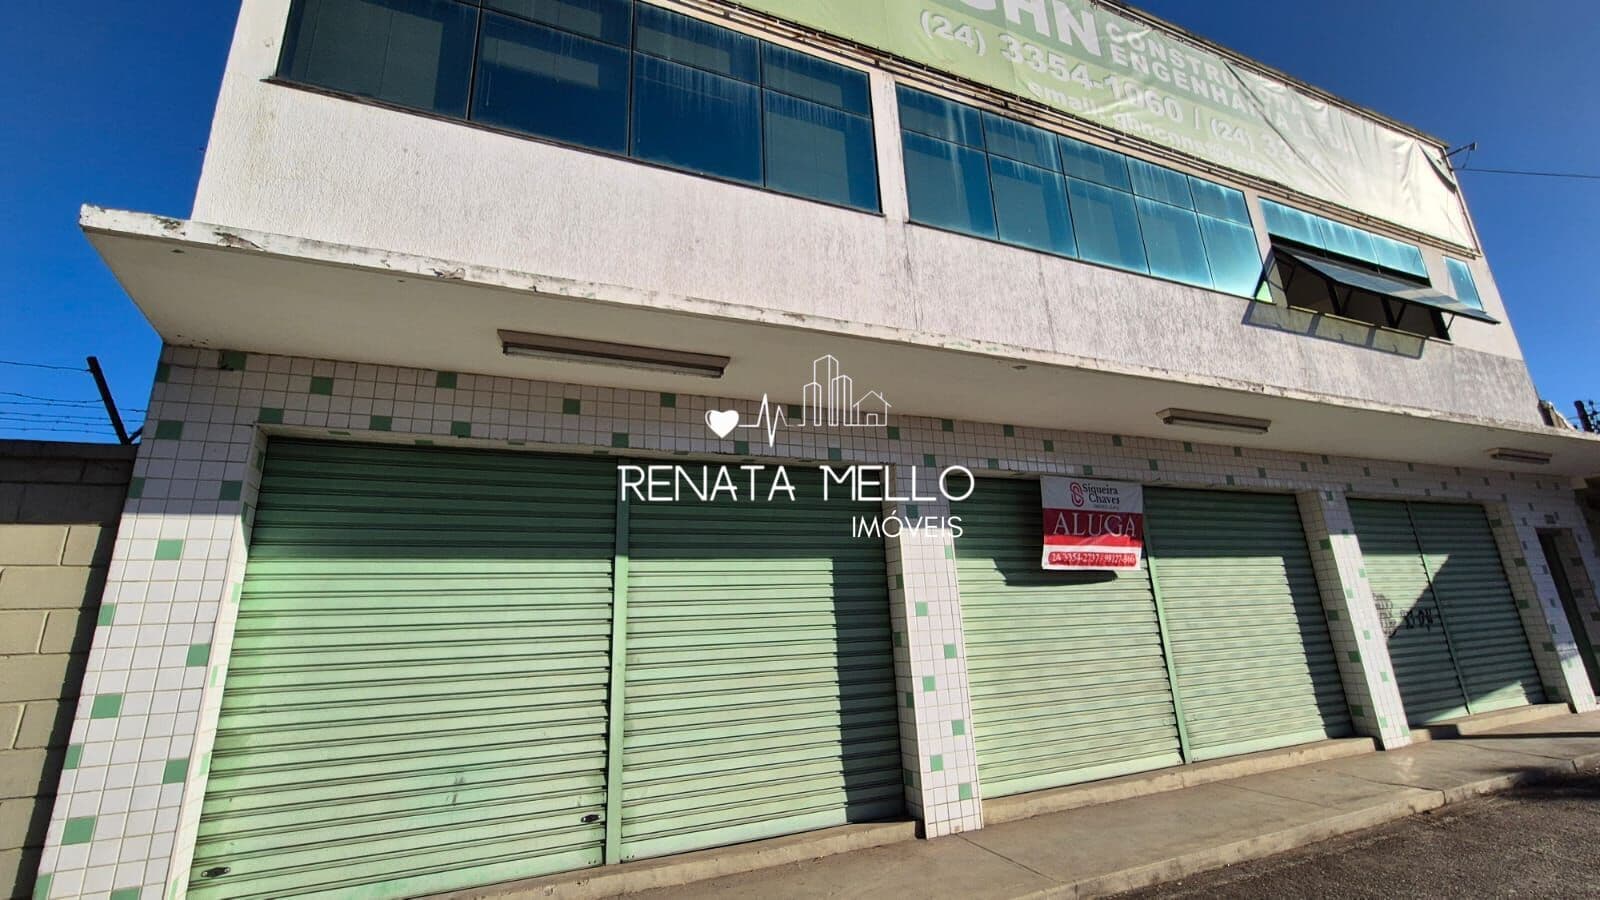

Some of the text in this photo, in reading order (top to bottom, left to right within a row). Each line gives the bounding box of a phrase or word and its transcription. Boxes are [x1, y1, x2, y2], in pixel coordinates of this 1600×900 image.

[953, 0, 1101, 57] HN
[921, 10, 986, 57] (24)
[1000, 33, 1184, 122] 3354-1060
[1106, 22, 1300, 115] CONSTRUORA
[1082, 483, 1119, 496] Siqueira
[1088, 493, 1120, 505] Chaves
[1053, 511, 1137, 538] ALUGA
